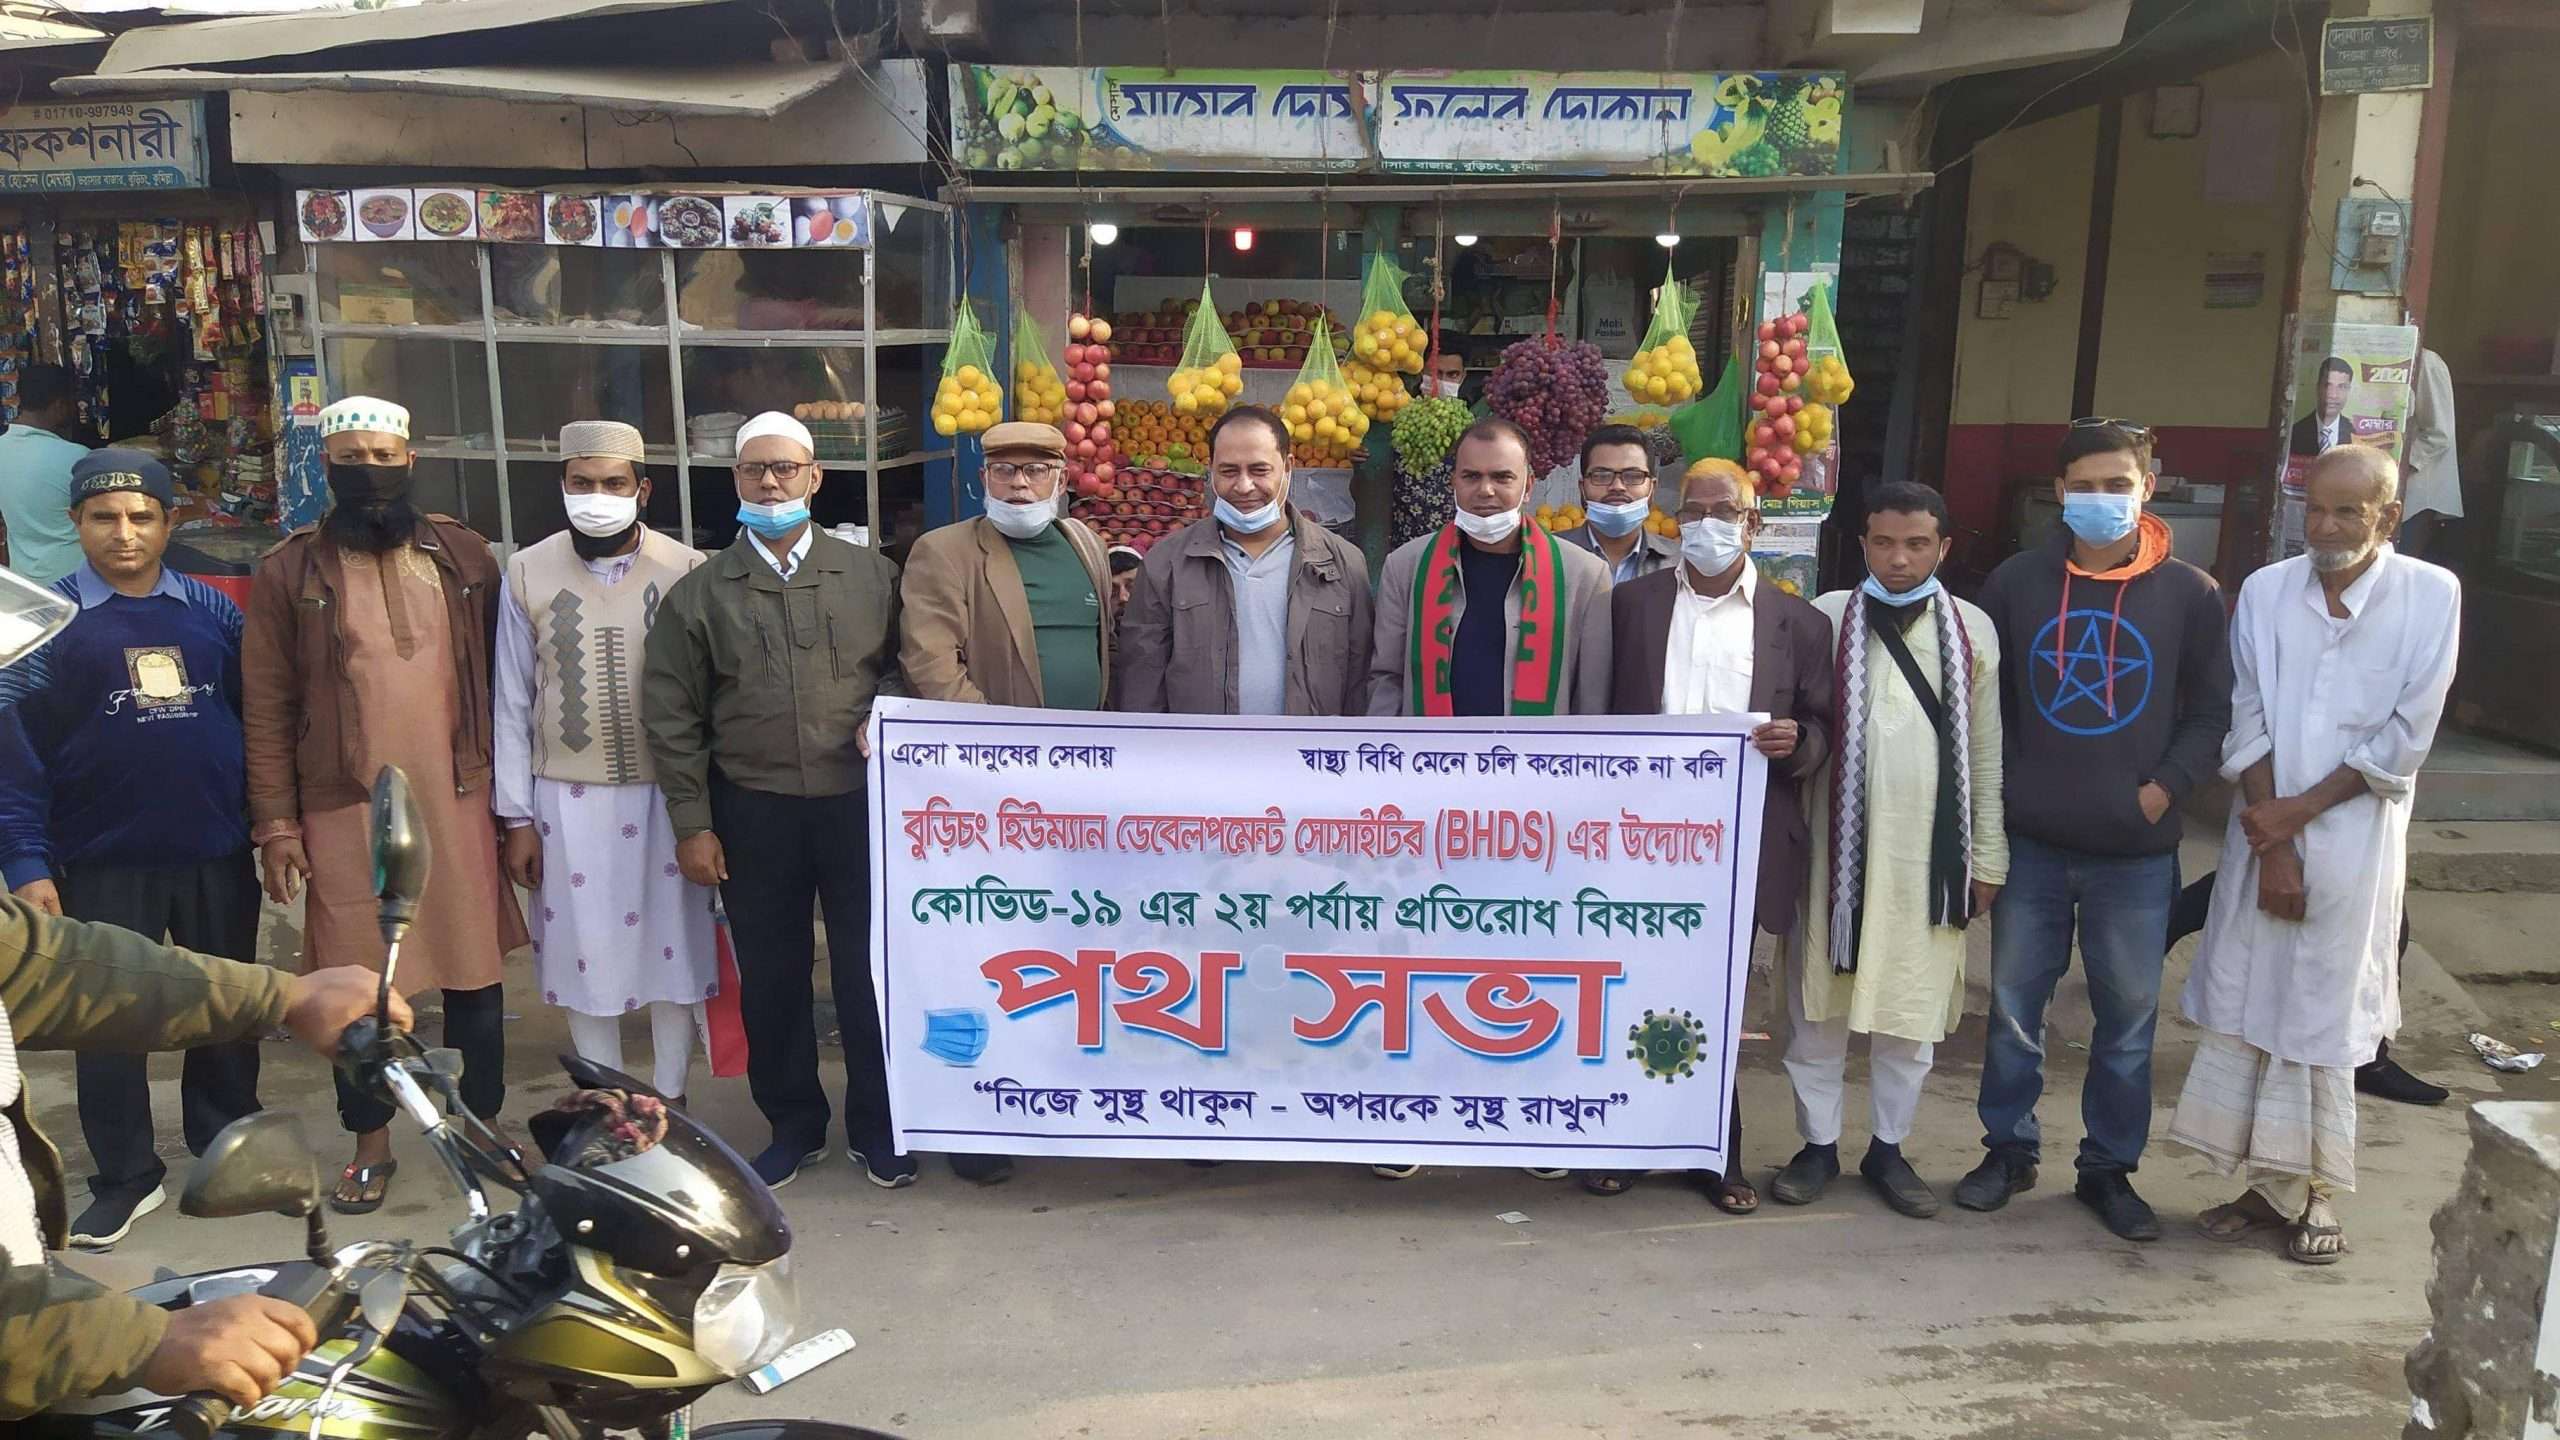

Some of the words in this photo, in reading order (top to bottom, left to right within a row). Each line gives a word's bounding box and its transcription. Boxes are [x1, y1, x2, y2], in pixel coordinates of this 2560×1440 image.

[891, 741, 949, 769] এসো
[957, 742, 1041, 774] মানুষের
[1048, 744, 1117, 770] সেবায়
[1298, 747, 1351, 778] স্বাস্থ্য
[1356, 742, 1406, 775] বিধি
[1412, 749, 1468, 777] মেনে
[1475, 745, 1518, 777] চলি
[1525, 753, 1641, 779] করোনাকে
[1648, 755, 1675, 779] না
[1682, 749, 1727, 780] বলি
[901, 795, 990, 862] বুড়িচং
[996, 797, 1109, 854] হিউম্যান
[1116, 805, 1287, 857] ডেবেলপমেন্ট
[1294, 803, 1426, 860] সোসাইটির
[1434, 807, 1555, 874] (BHDS)
[1567, 816, 1613, 863] এর
[1619, 807, 1725, 865] উদ্যোগে
[911, 874, 1123, 929] কোভিড-১৯
[1139, 889, 1200, 928] এর
[1214, 890, 1272, 932] ২য়
[1285, 881, 1384, 933] পর্যায়
[1394, 883, 1563, 938] প্রতিরোধ
[1572, 887, 1707, 938] বিষয়ক
[978, 949, 1243, 1052] পথ
[1283, 953, 1627, 1061] সভা
[1093, 1087, 1150, 1125] সুস্থ
[1159, 1085, 1258, 1129] থাকুন
[1301, 1090, 1441, 1123] অপরকে
[1450, 1093, 1511, 1132] সুস্থ
